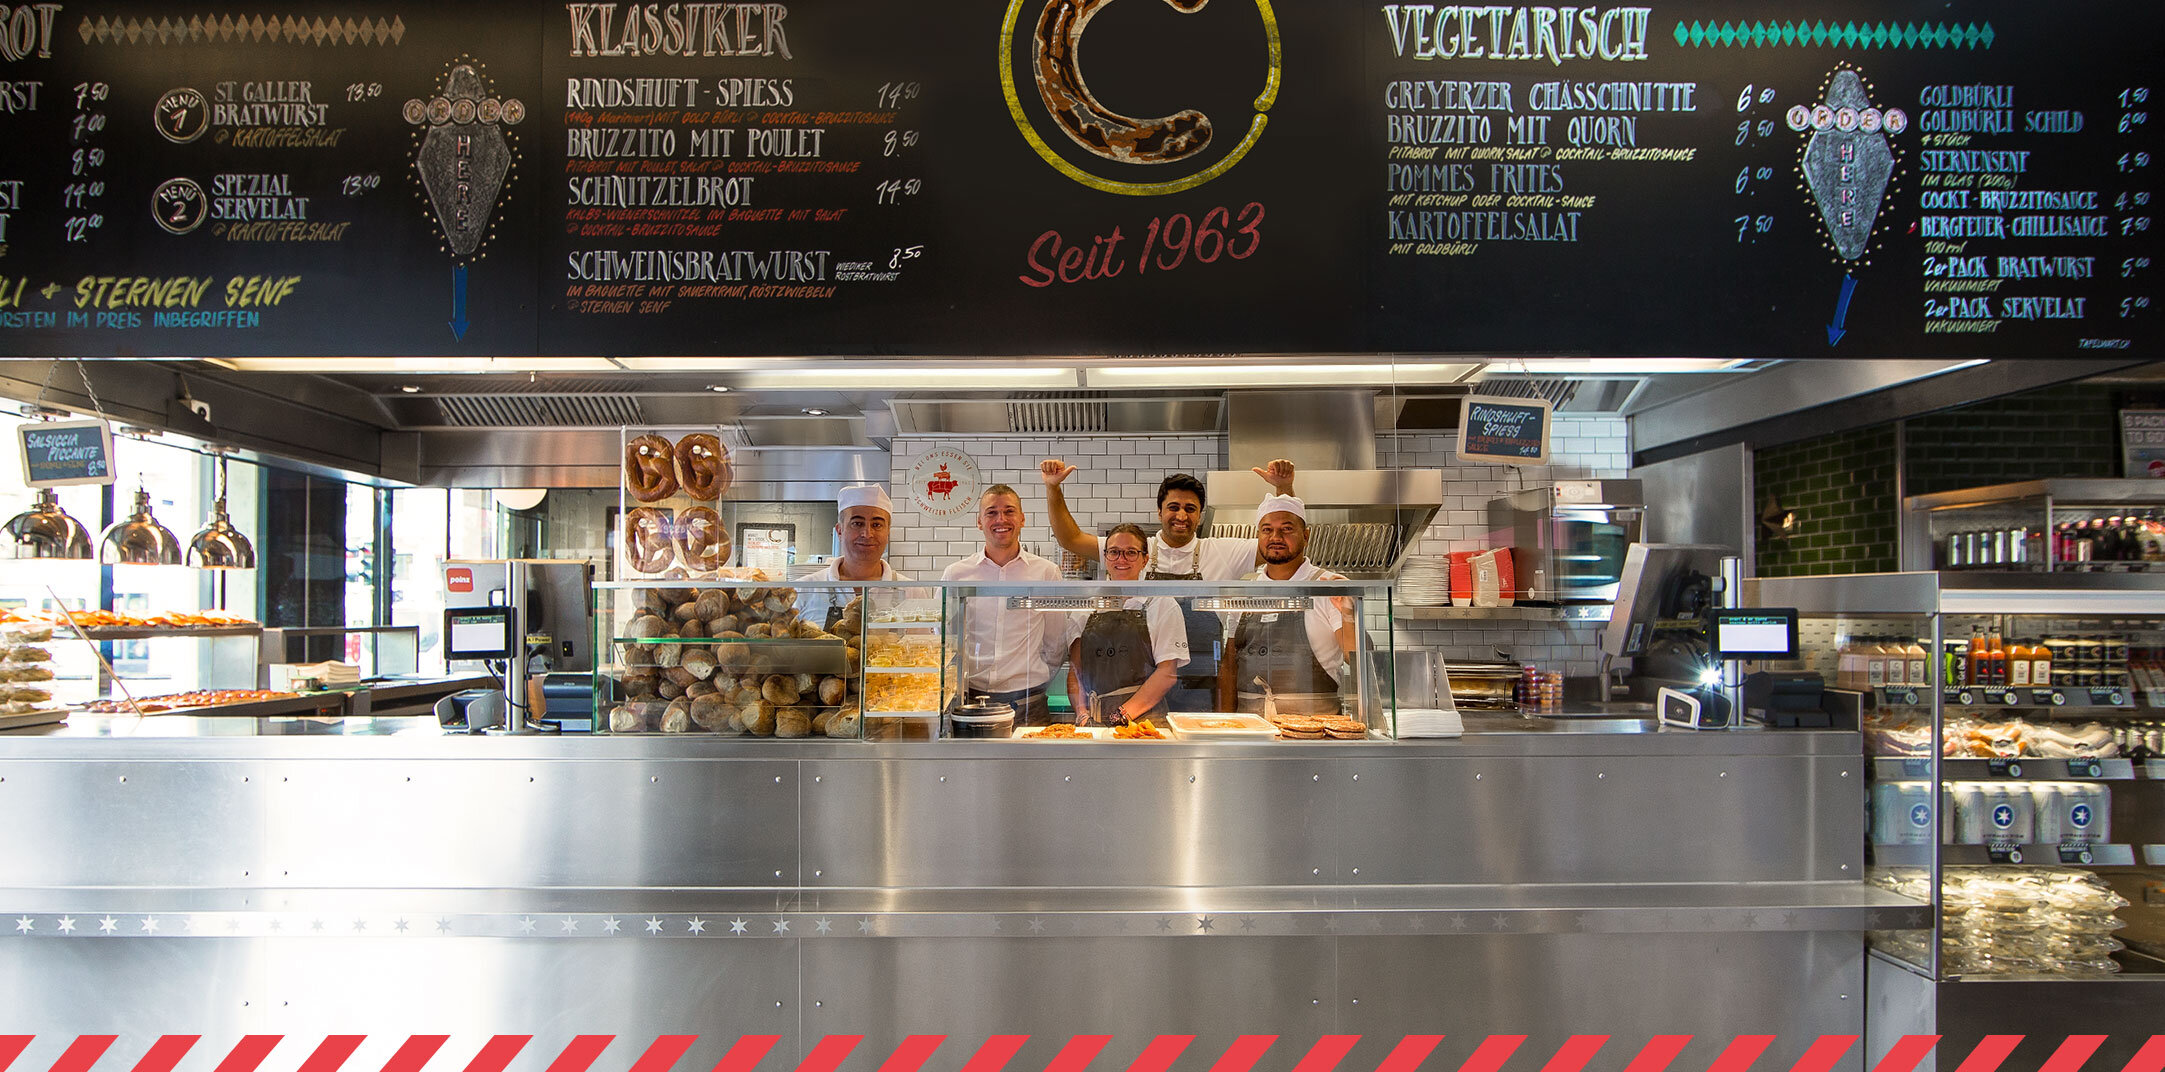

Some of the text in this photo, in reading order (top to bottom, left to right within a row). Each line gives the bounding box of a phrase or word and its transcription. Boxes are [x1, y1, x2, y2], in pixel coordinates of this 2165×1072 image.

[566, 2, 793, 61] KLASSIKER
[1382, 5, 1651, 66] VEGETARISCH
[215, 81, 237, 101] ST
[243, 81, 312, 106] GALLER
[567, 78, 699, 110] RINDSHUFT
[716, 78, 794, 108] SPIESS
[1385, 80, 1513, 113] GREYERZER
[1529, 79, 1696, 112] CHÄSSCHNITTE
[213, 103, 329, 127] BRATWURST
[404, 99, 523, 124] ORDER
[1788, 106, 1905, 133] ORDER
[2024, 111, 2084, 133] SCHILD
[232, 128, 347, 148] KARTOFFELSALAT
[1387, 115, 1491, 145] BRUZZITO
[1506, 115, 1551, 145] MIT
[1567, 115, 1637, 147] QUORN
[567, 128, 676, 160] BRUZZITO
[688, 129, 735, 158] MIT
[747, 128, 825, 158] POULET
[1388, 146, 1438, 160] PITABROT
[1445, 147, 1470, 159] MIT
[1506, 147, 1540, 160] SALAT
[565, 160, 614, 173] PITABROT
[616, 160, 638, 173] MIT
[1920, 151, 2030, 174] STERNENSENF
[212, 174, 292, 196] SPEZIAL
[456, 134, 473, 232] HERE
[1387, 164, 1475, 192] POMMES
[1491, 164, 1563, 195] FRITES
[1841, 144, 1855, 226] HERE
[1943, 174, 1973, 187] GLAS
[568, 175, 755, 209] SCHNITZELBROT
[1389, 194, 1415, 207] MIT
[1417, 194, 1468, 207] KETCHUP
[1472, 194, 1502, 207] ODER
[170, 201, 187, 223] 2
[211, 198, 309, 221] SERVELAT
[706, 208, 726, 221] IM
[728, 208, 784, 222] BAGUETTE
[787, 208, 812, 222] MIT
[814, 208, 848, 222] SALAT
[226, 221, 351, 241] KARTOFFELSALAT
[1388, 211, 1581, 243] KARTOFFELSALAT
[1019, 202, 1265, 287] Seit 1963
[1389, 243, 1414, 255] MIT
[568, 250, 830, 283] SCHWEINSBRATWURST
[1997, 257, 2095, 280] BRATWURST
[0, 275, 28, 308] LI
[74, 274, 214, 309] STERNEN
[224, 274, 301, 308] SENF
[566, 285, 581, 297] IM
[585, 284, 646, 297] BAGUETTE
[648, 285, 675, 297] MIT
[1924, 279, 2003, 292] VAKUUMIERT
[580, 300, 671, 313] STERNEN SENF
[2001, 297, 2086, 320] SERVELAT
[67, 311, 89, 328] IM
[96, 311, 142, 330] PREIS
[153, 310, 260, 328] INBEGRIFFEN
[1924, 320, 2002, 333] VAKUUMIERT
[27, 433, 79, 449] SALSICCIA
[1482, 422, 1521, 438] SPIESS
[48, 447, 98, 461] PICCANTE
